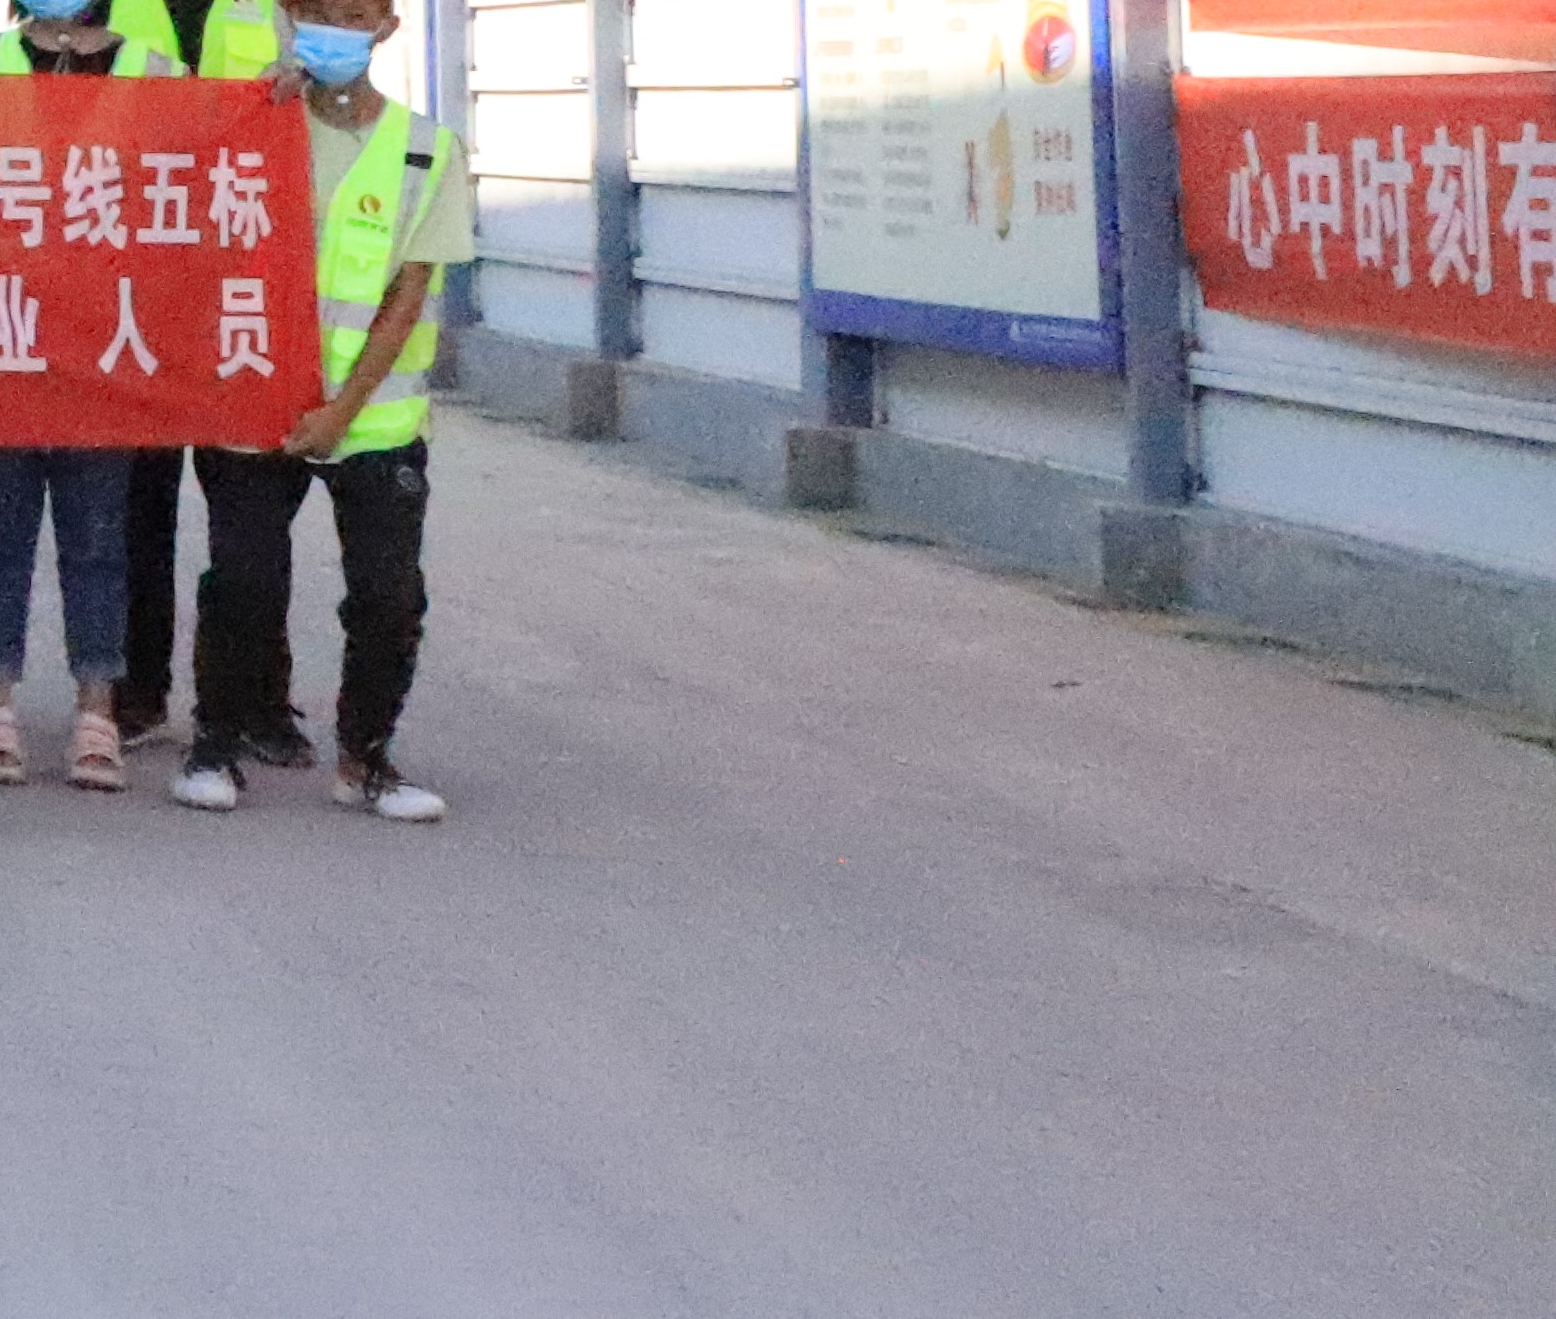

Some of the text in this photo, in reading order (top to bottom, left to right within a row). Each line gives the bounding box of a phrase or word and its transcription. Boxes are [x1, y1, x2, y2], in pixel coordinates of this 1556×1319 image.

[1227, 120, 1556, 307] 心中时刻有
